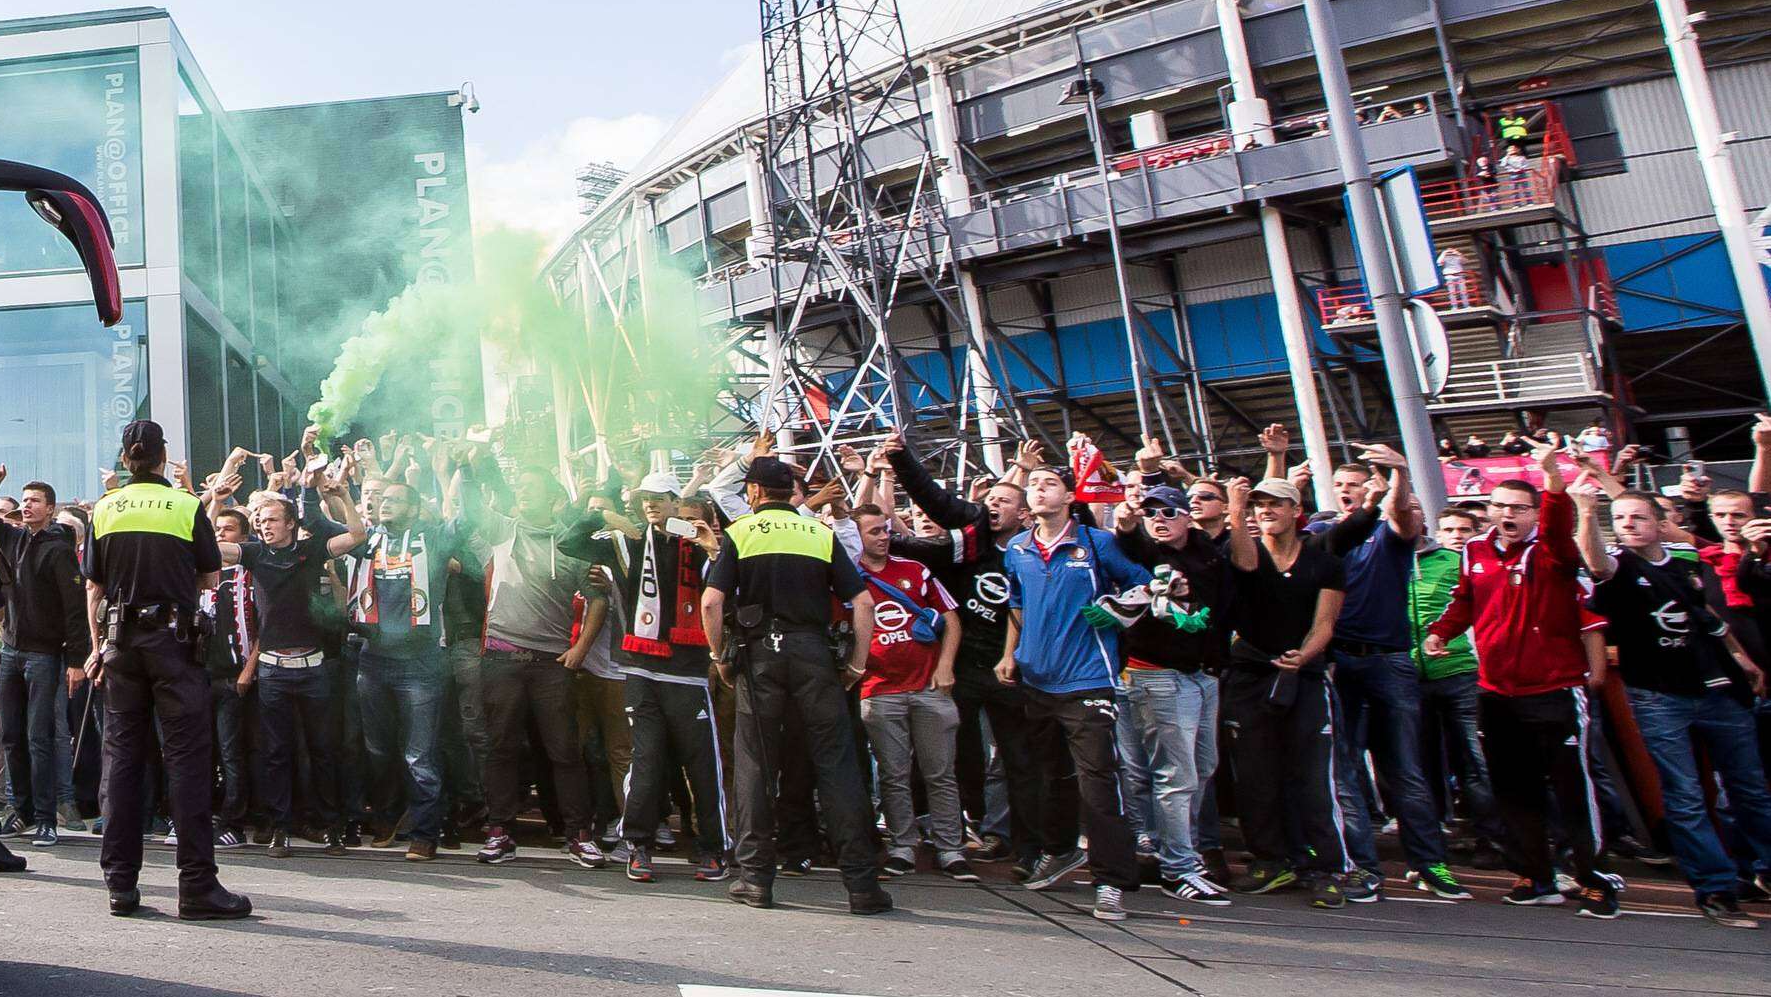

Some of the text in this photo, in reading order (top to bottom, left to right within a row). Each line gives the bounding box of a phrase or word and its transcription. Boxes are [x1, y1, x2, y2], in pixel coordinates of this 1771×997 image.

[104, 72, 130, 245] PLAN@OFFICE
[966, 598, 997, 623] OPEL
[878, 630, 913, 645] OPEL
